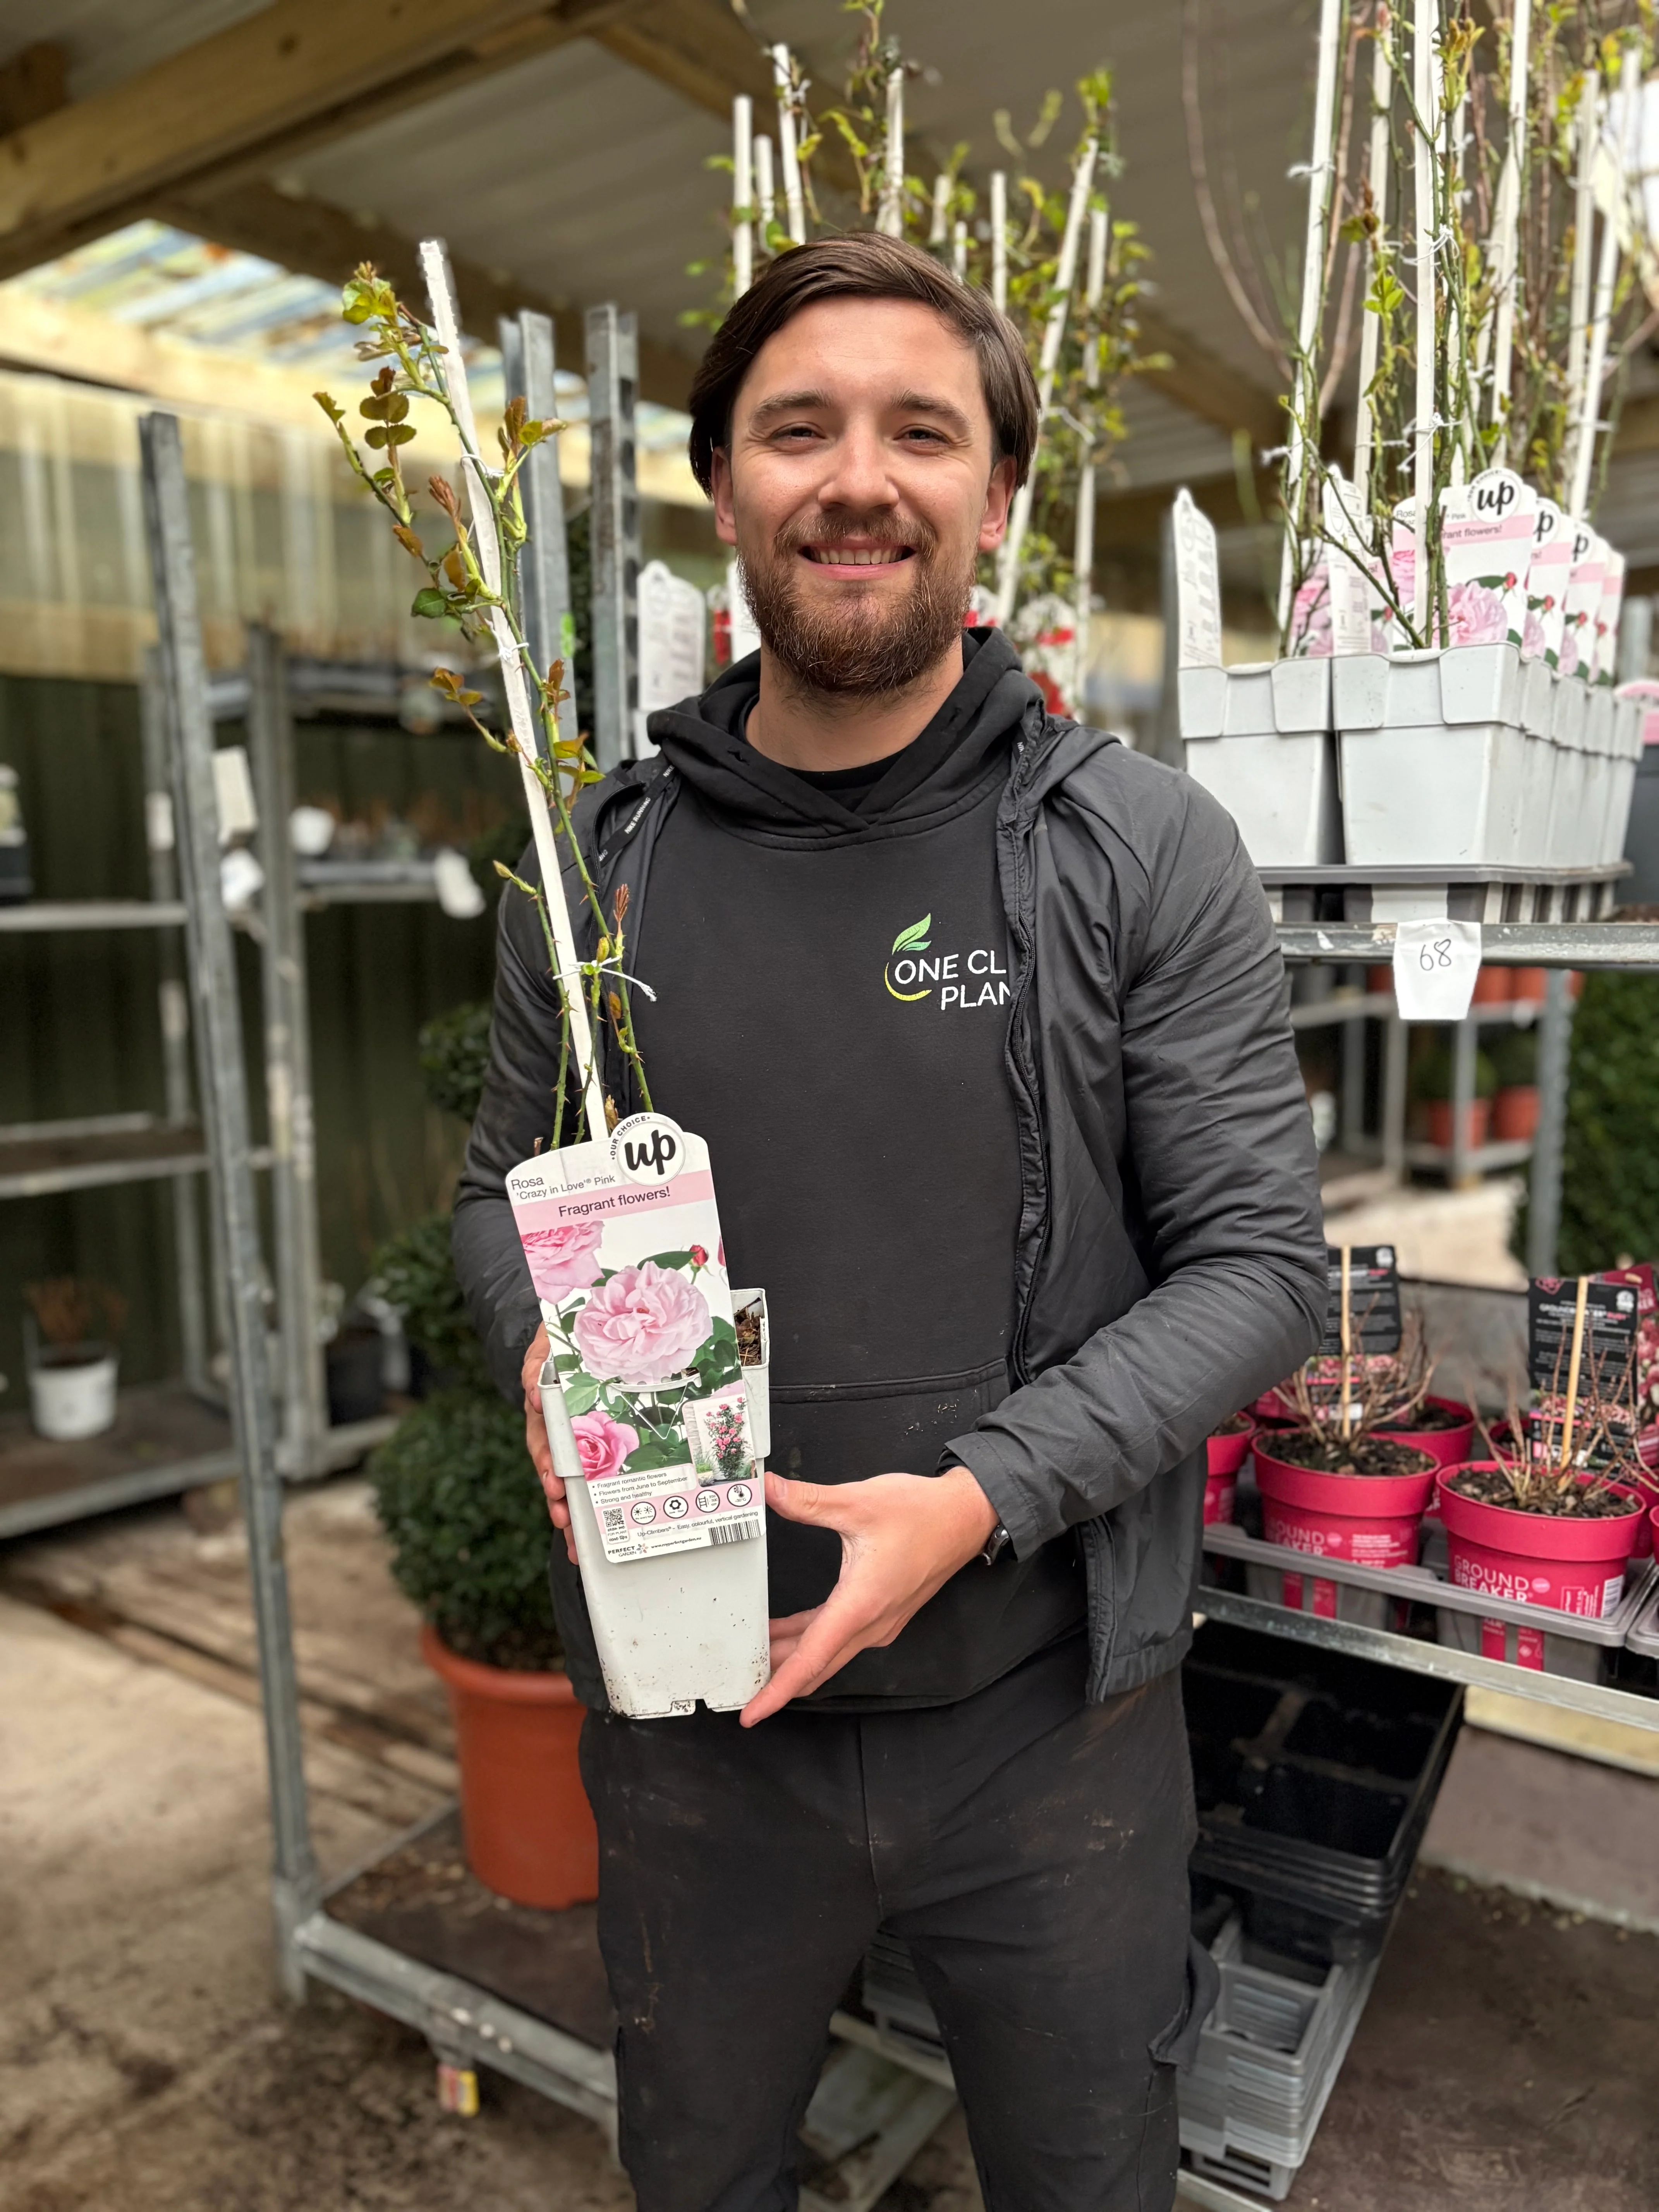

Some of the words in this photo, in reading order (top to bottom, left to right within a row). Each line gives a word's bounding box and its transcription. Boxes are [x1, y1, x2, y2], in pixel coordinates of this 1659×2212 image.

[1477, 481, 1514, 515] up
[1465, 524, 1502, 536] flowers!
[663, 765, 675, 777] NIKE
[624, 821, 636, 834] NIKE
[633, 797, 651, 822] RUNNING
[1420, 939, 1451, 971] 68
[895, 954, 959, 984] ONE
[610, 1139, 618, 1156] OUR
[617, 1116, 646, 1136] CHOICE
[625, 1130, 676, 1175] up
[511, 1177, 544, 1190] Rosa
[550, 1186, 558, 1194] in
[594, 1175, 615, 1185] Pink
[559, 1197, 615, 1217] Fragrant
[618, 1186, 670, 1206] flowers!
[597, 1480, 620, 1489] Fragrant
[599, 1488, 621, 1496] Flowers
[658, 1477, 688, 1486] September
[632, 1491, 652, 1499] healthy
[734, 1511, 758, 1520] gardening
[608, 1546, 635, 1554] PERFECT
[1454, 1555, 1529, 1591] GROUND
